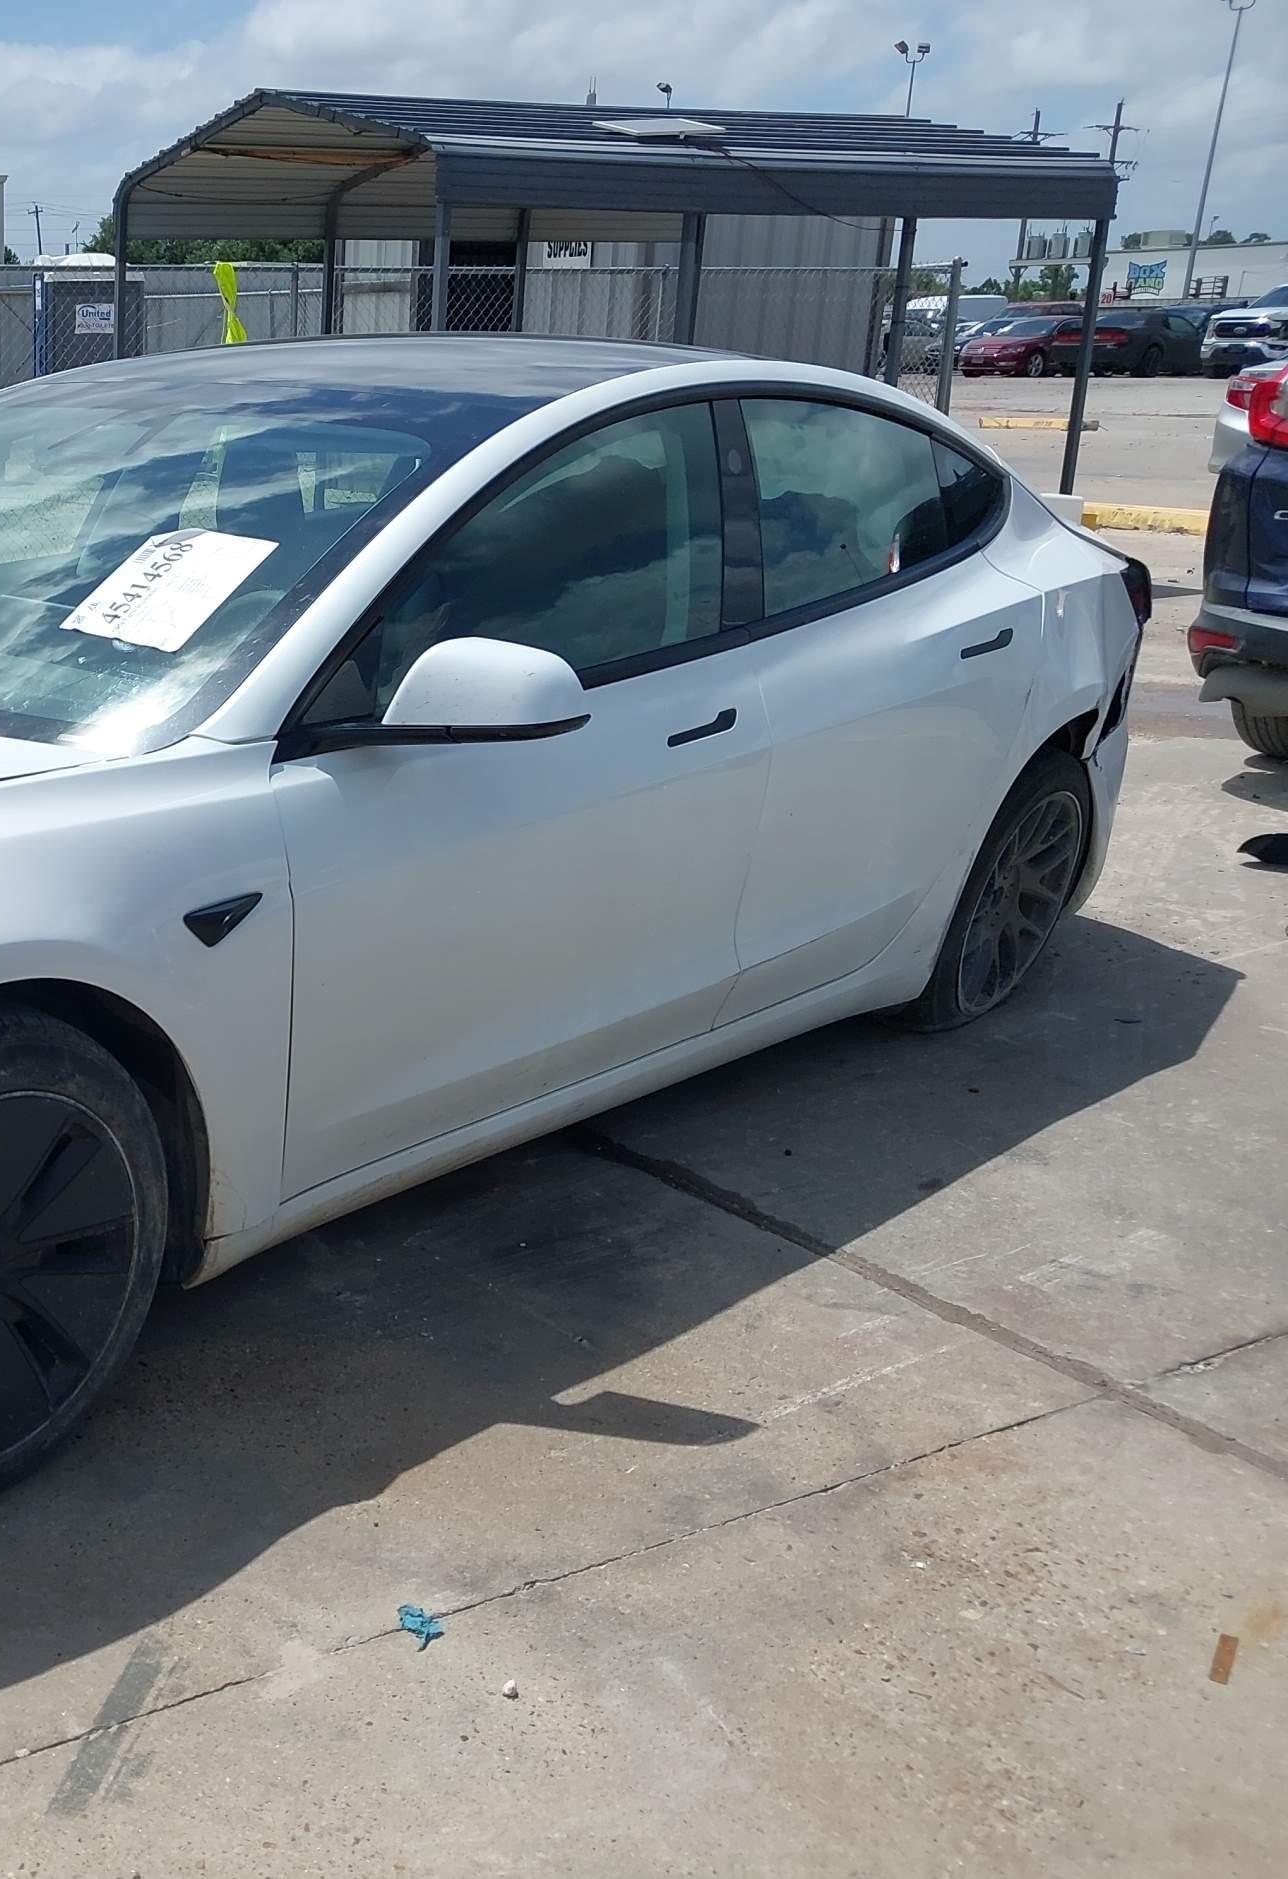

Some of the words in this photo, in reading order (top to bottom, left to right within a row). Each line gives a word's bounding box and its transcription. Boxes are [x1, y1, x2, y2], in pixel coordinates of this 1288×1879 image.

[547, 241, 588, 258] SUPPLIES
[1101, 293, 1112, 304] 20
[81, 309, 111, 318] United
[102, 542, 193, 624] 45414568
